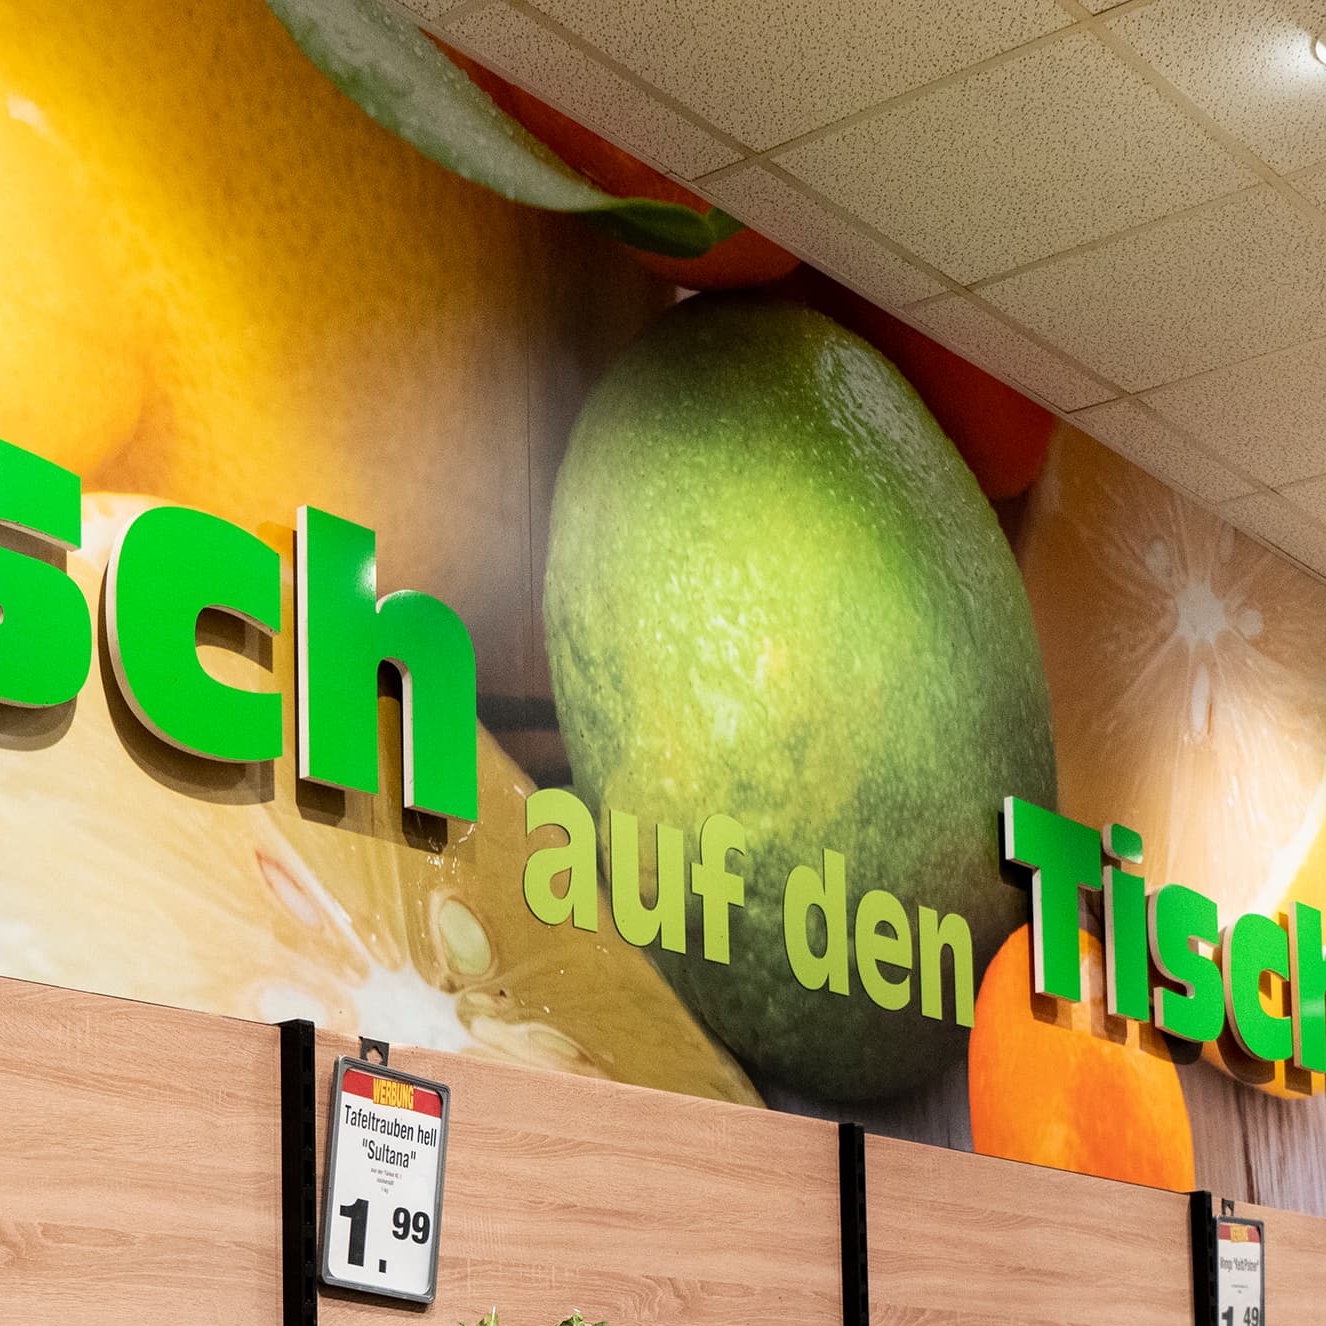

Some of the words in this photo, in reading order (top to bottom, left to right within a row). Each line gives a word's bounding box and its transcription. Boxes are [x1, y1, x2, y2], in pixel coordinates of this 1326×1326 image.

[523, 787, 745, 965] auf
[783, 849, 975, 1028] den
[372, 1078, 415, 1110] WERBUNG
[345, 1104, 414, 1142] Tafeltrauben
[417, 1121, 437, 1148] hell
[362, 1137, 417, 1169] "Sultana"
